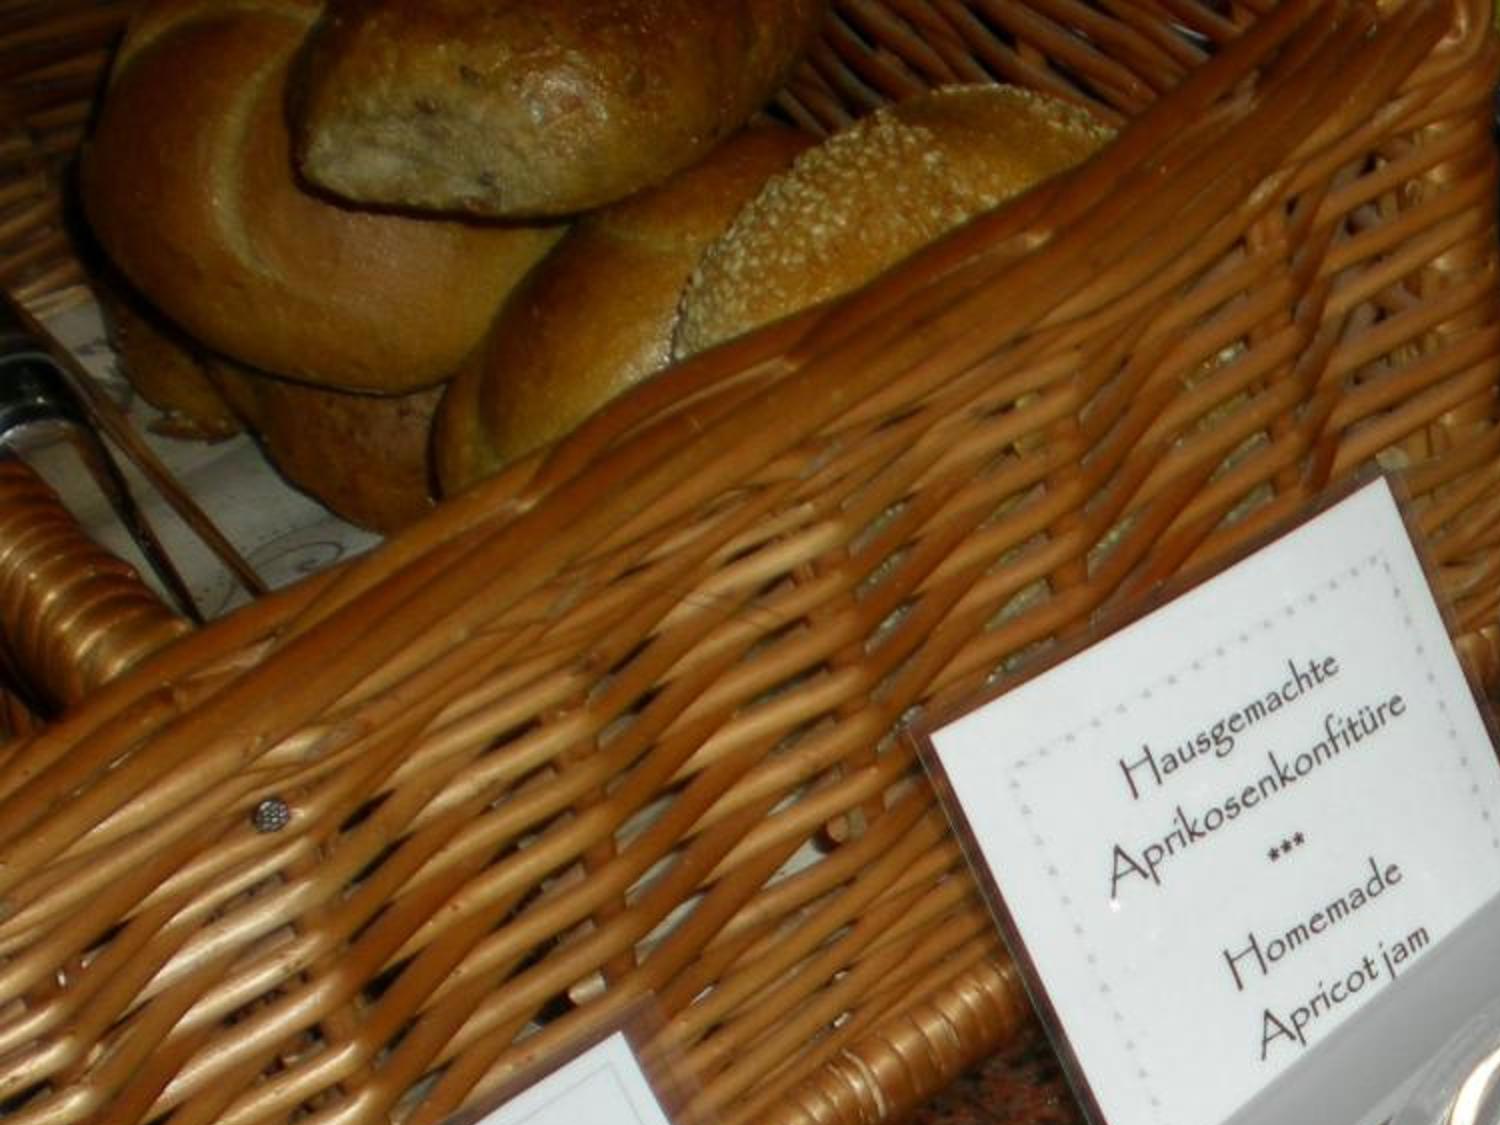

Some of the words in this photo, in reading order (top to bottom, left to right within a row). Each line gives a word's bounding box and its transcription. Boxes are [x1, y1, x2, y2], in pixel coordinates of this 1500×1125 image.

[1109, 694, 1407, 900] Aprikosenkonfitüre
[1118, 655, 1340, 801] Hausgemachte
[1221, 855, 1404, 993] Homemade
[1260, 954, 1380, 1062] Apricot
[1378, 926, 1431, 980] jam
